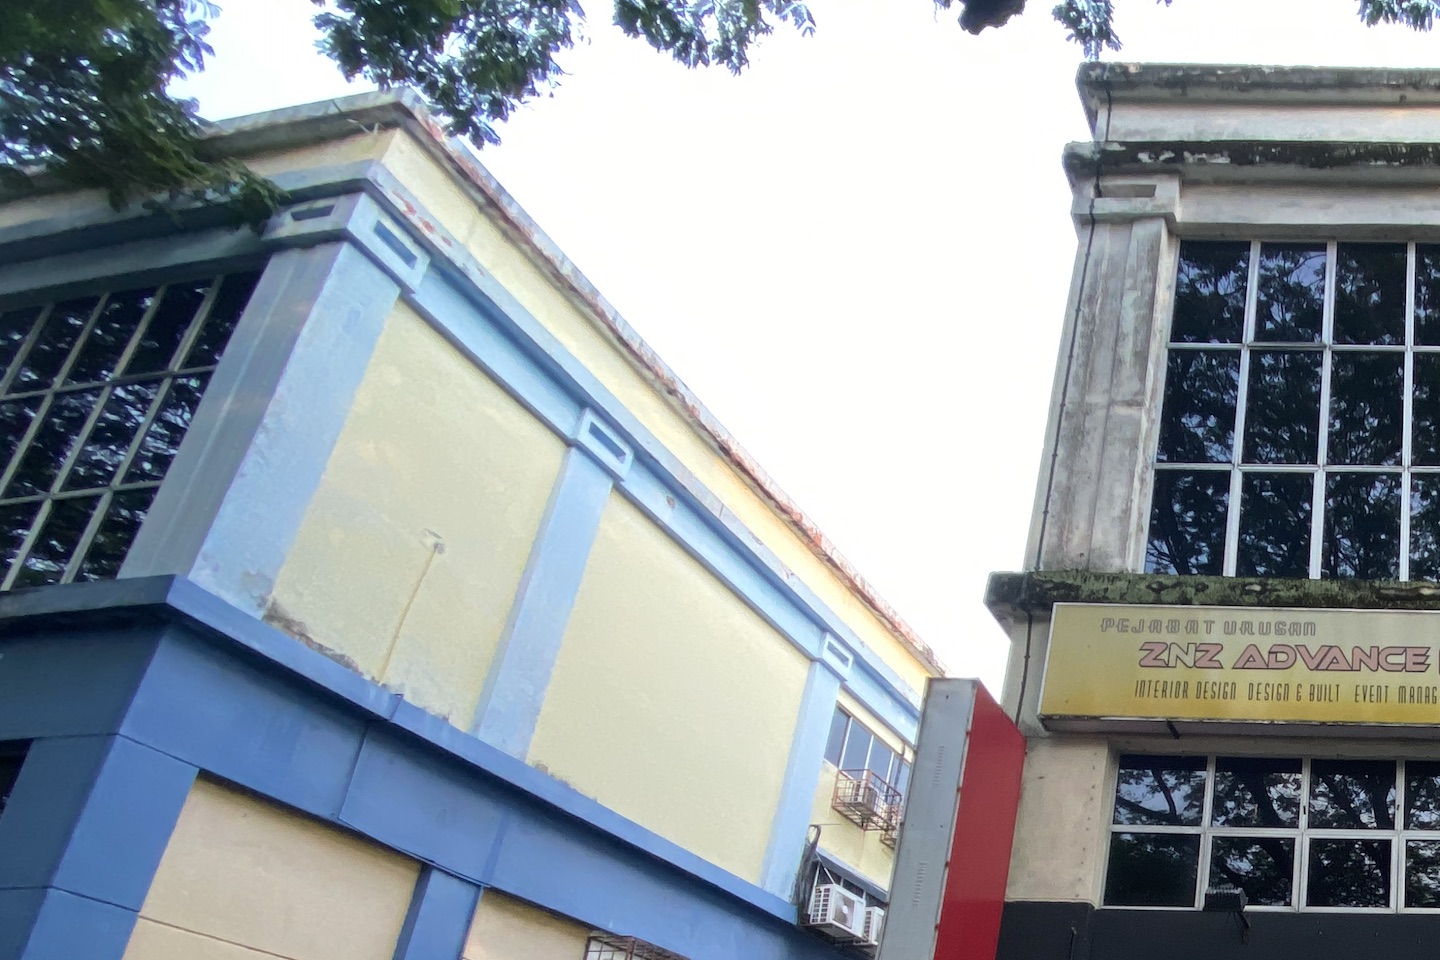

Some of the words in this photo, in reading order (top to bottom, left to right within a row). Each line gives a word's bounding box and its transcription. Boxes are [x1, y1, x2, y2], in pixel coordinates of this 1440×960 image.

[1100, 617, 1216, 635] PEJABAT
[1222, 619, 1317, 637] URUSAN
[1138, 641, 1225, 670] ZNZ
[1231, 643, 1432, 673] ADVANCE
[1134, 679, 1190, 700] INTERIOR
[1195, 681, 1237, 701] DESIGN
[1247, 682, 1290, 702] DESIGN
[1308, 683, 1341, 703] BUILT
[1353, 684, 1390, 704] EVENT
